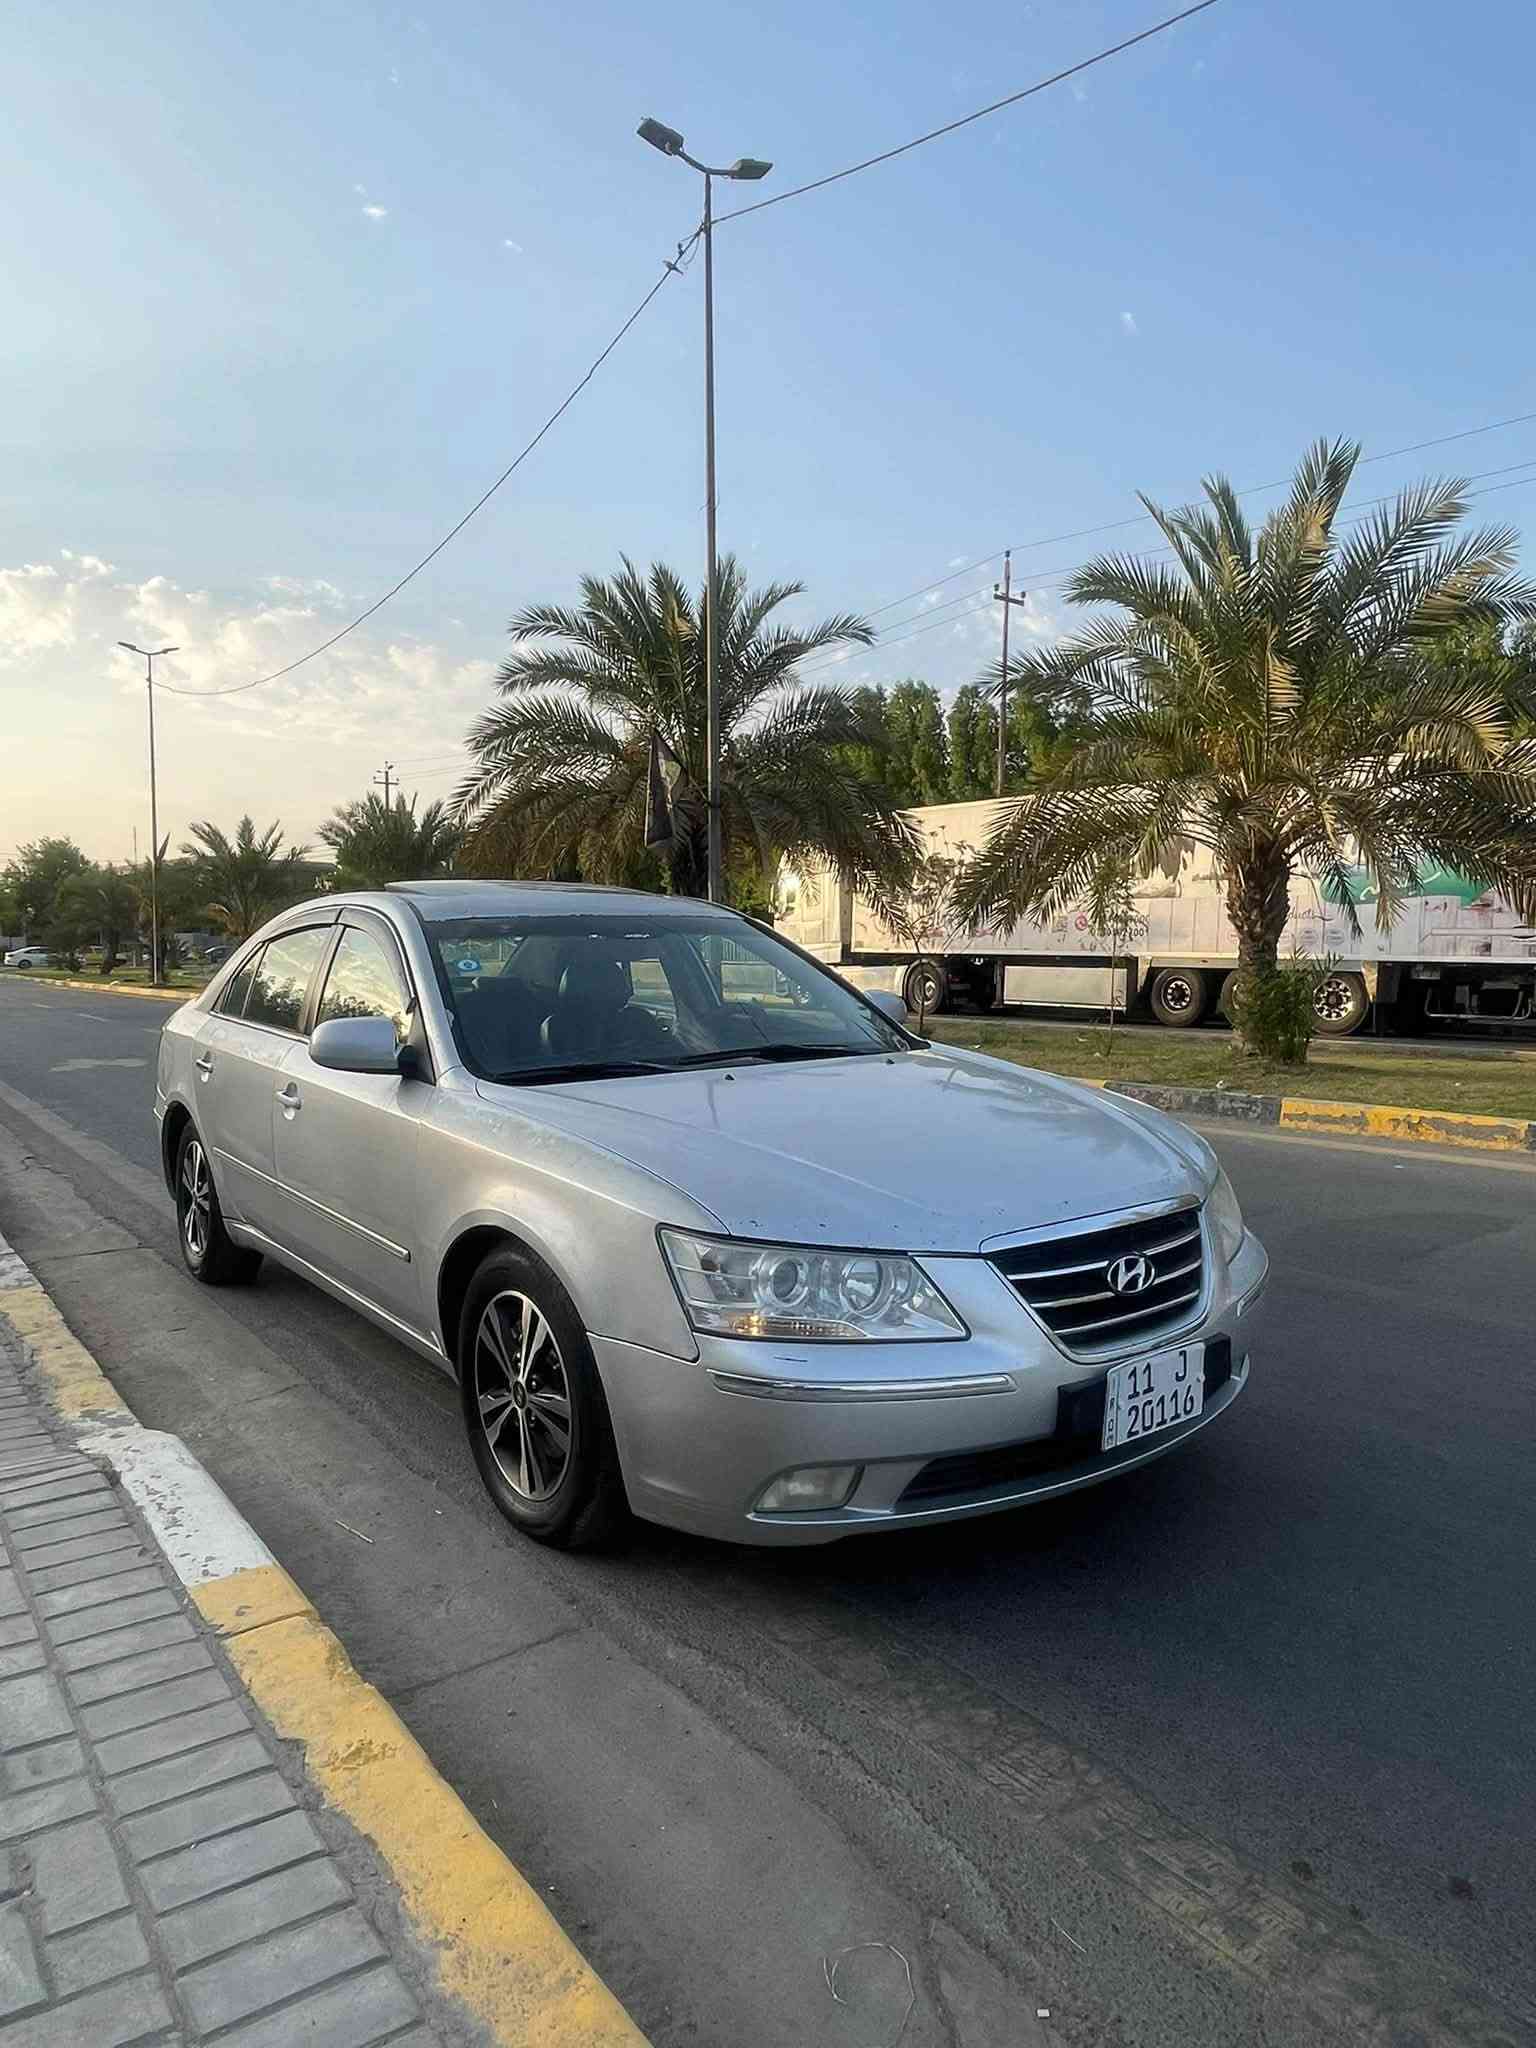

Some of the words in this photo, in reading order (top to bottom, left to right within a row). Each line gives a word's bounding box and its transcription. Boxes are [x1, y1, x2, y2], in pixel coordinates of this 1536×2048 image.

[1127, 1362, 1155, 1400] 11
[1175, 1350, 1188, 1382] J
[1127, 1384, 1195, 1439] 20116
